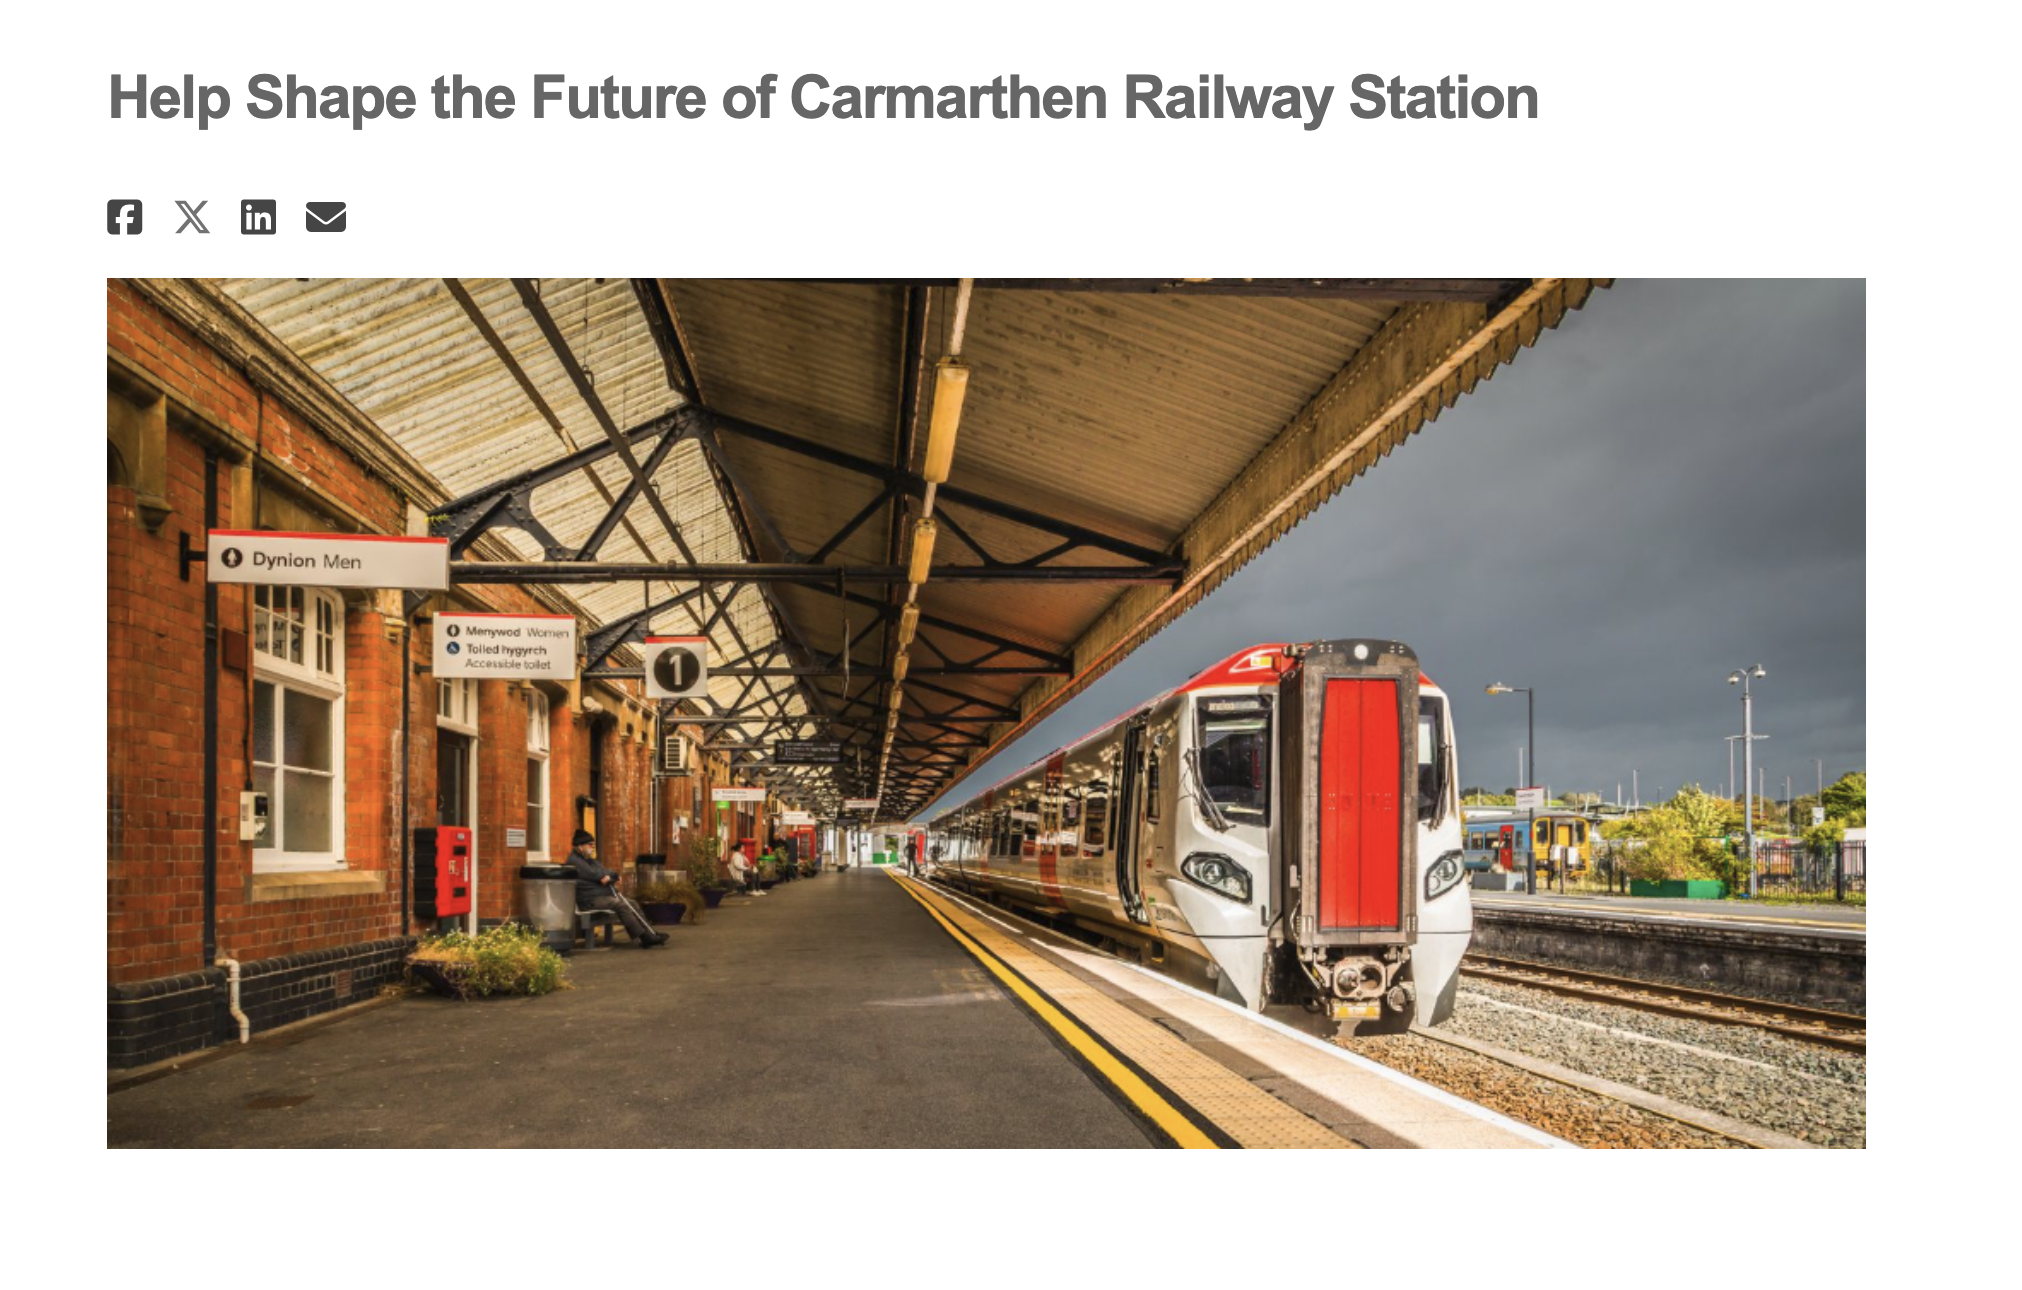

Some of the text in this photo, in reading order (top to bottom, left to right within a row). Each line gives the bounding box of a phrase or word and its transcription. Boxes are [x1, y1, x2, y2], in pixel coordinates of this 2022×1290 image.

[253, 551, 361, 571] Dynion Men
[465, 626, 569, 639] Menywod Women
[464, 658, 551, 670] Accessible toilet
[669, 654, 682, 686] 1
